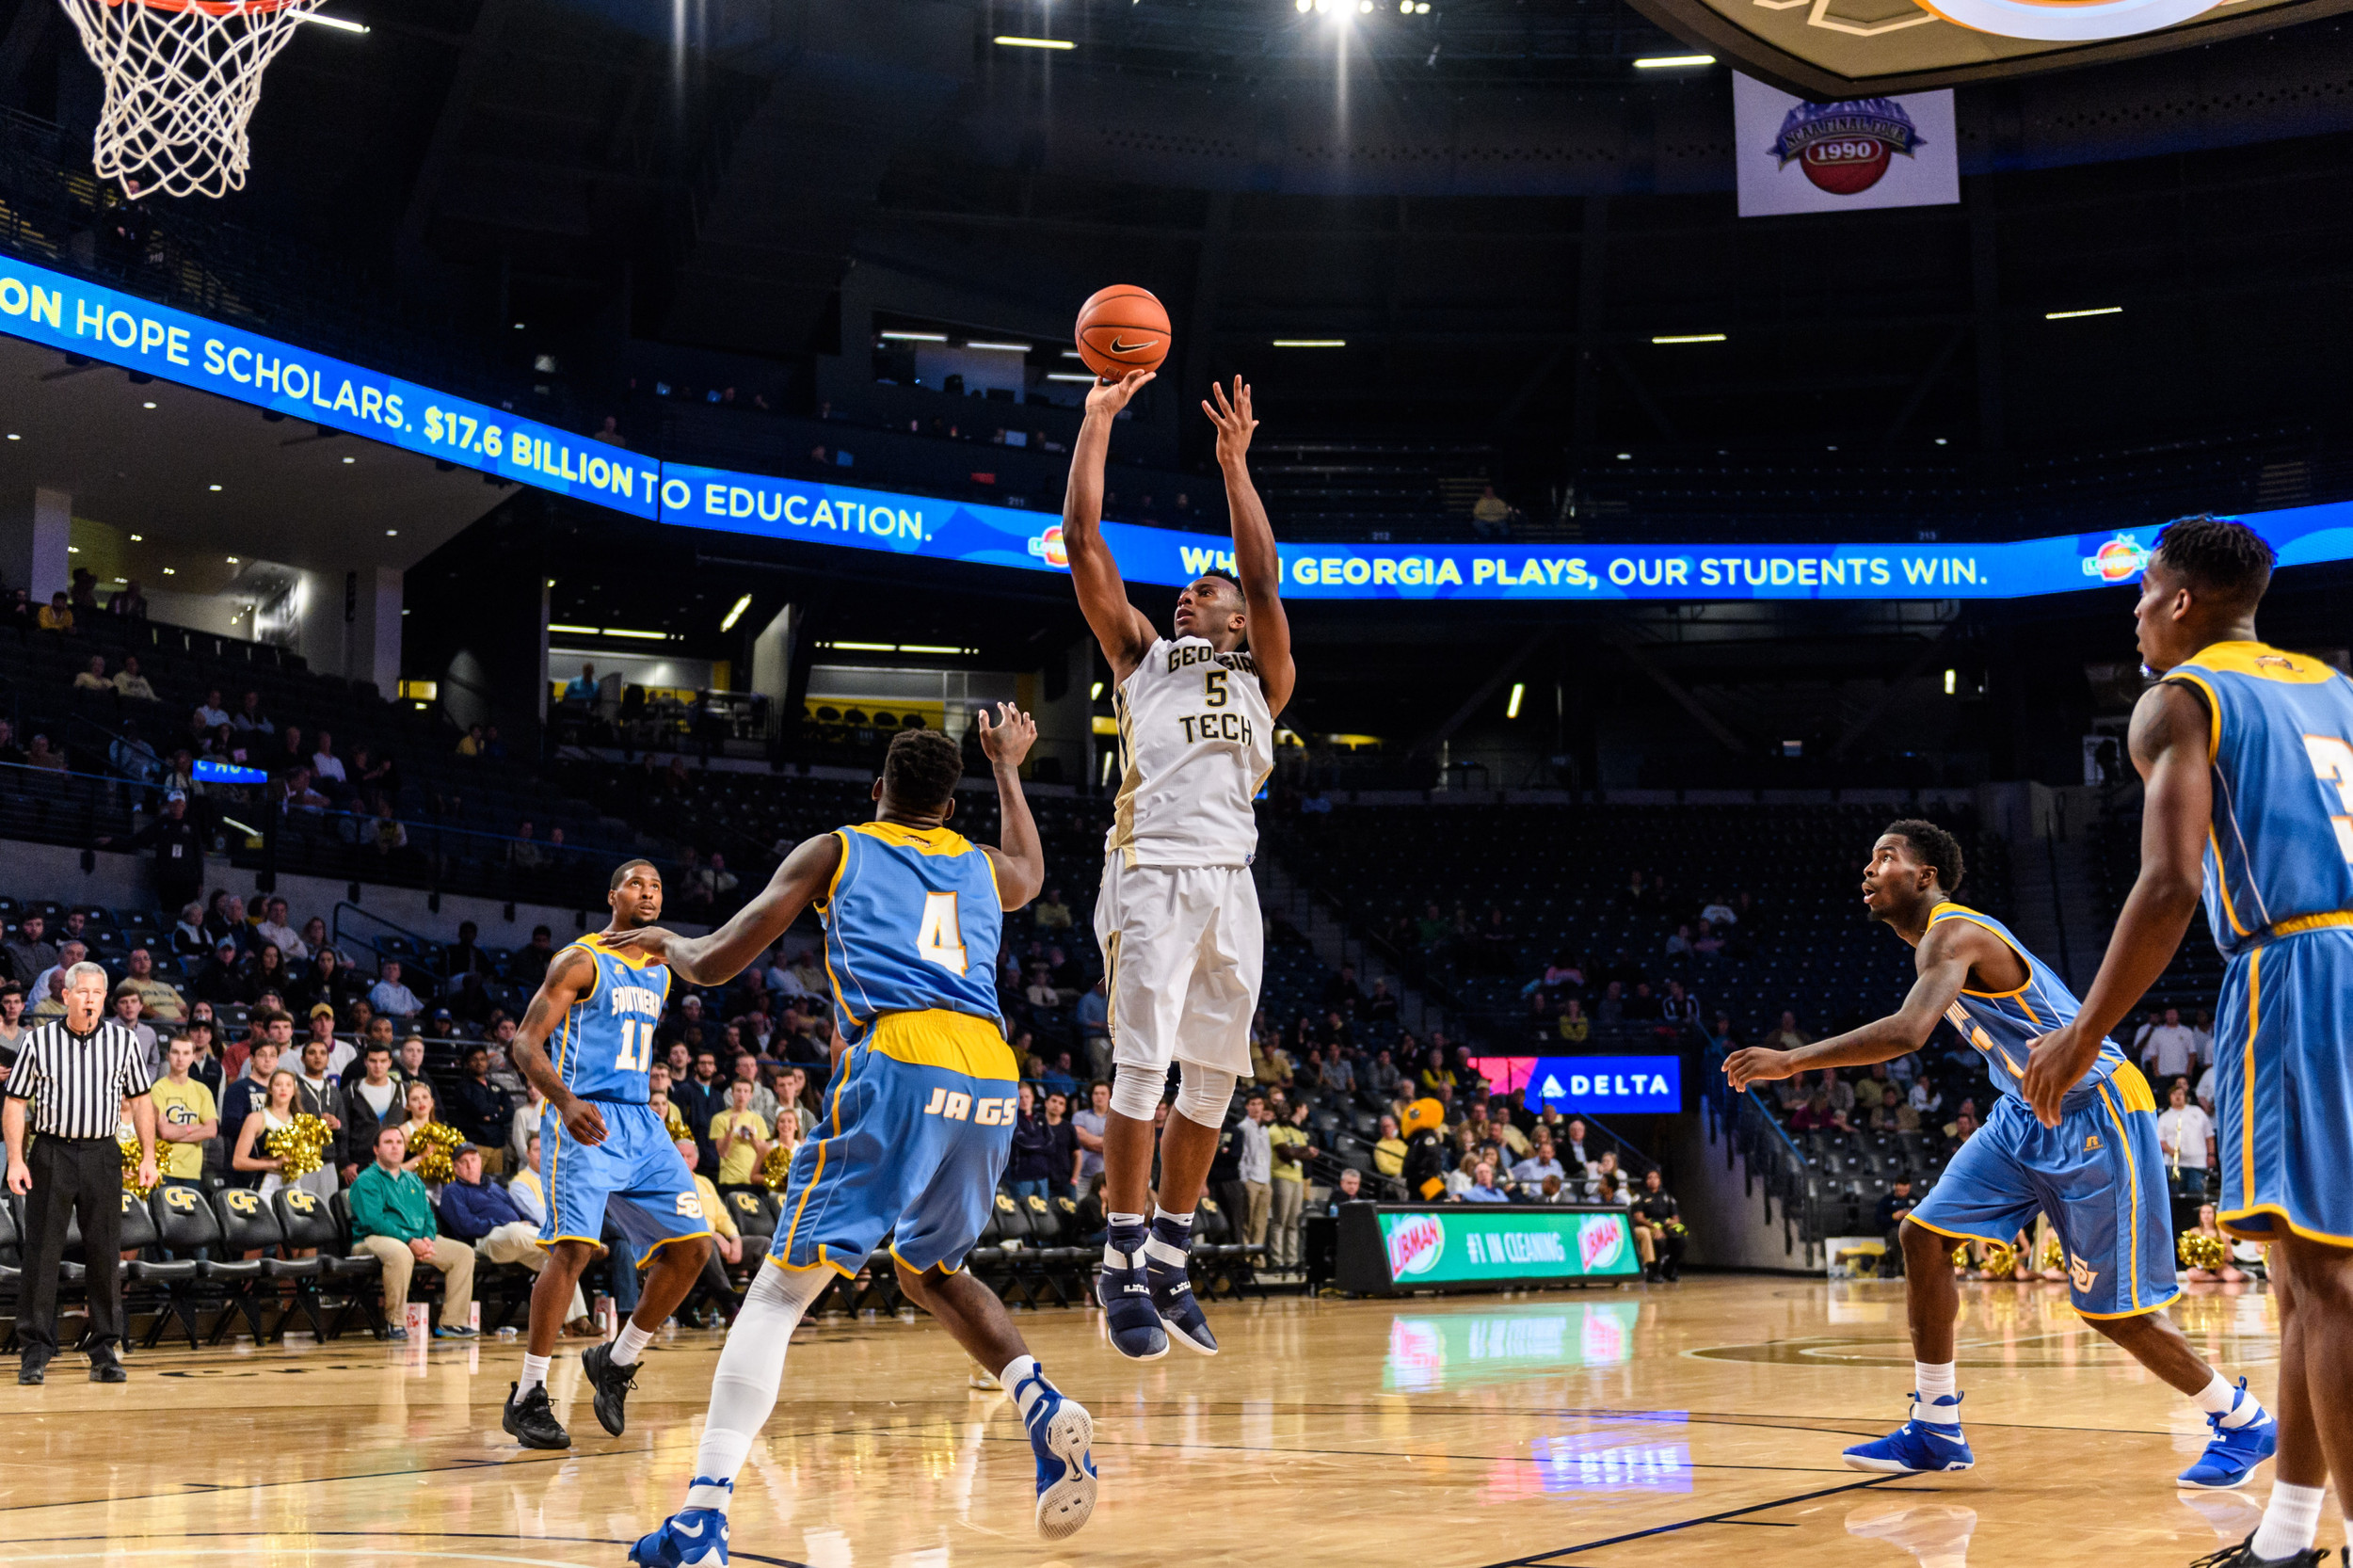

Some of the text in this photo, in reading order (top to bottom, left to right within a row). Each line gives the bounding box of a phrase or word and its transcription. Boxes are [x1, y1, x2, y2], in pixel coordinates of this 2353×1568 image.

[1824, 117, 1868, 135] FINAL
[1817, 141, 1872, 161] 1990
[0, 277, 933, 541] ON HOPE SCHOLARS. $17.6 BILLION TO EDUCATION.
[1292, 557, 1463, 585] GEORGIA
[1473, 557, 1598, 590] PLAYS,
[1609, 558, 1688, 585] OUR
[1701, 558, 1890, 585] STUDENTS
[1901, 558, 1988, 585] WIN.
[1206, 669, 1228, 708] 5
[1178, 713, 1252, 747] TECH
[917, 891, 968, 979] 4
[1570, 1074, 1670, 1096] DELTA
[924, 1087, 1016, 1127] JAGS
[164, 1187, 196, 1211] GT
[227, 1190, 259, 1214] GT
[286, 1189, 316, 1213] GT
[676, 1191, 704, 1219] SU
[1465, 1231, 1566, 1264] #1 IN CLEANING
